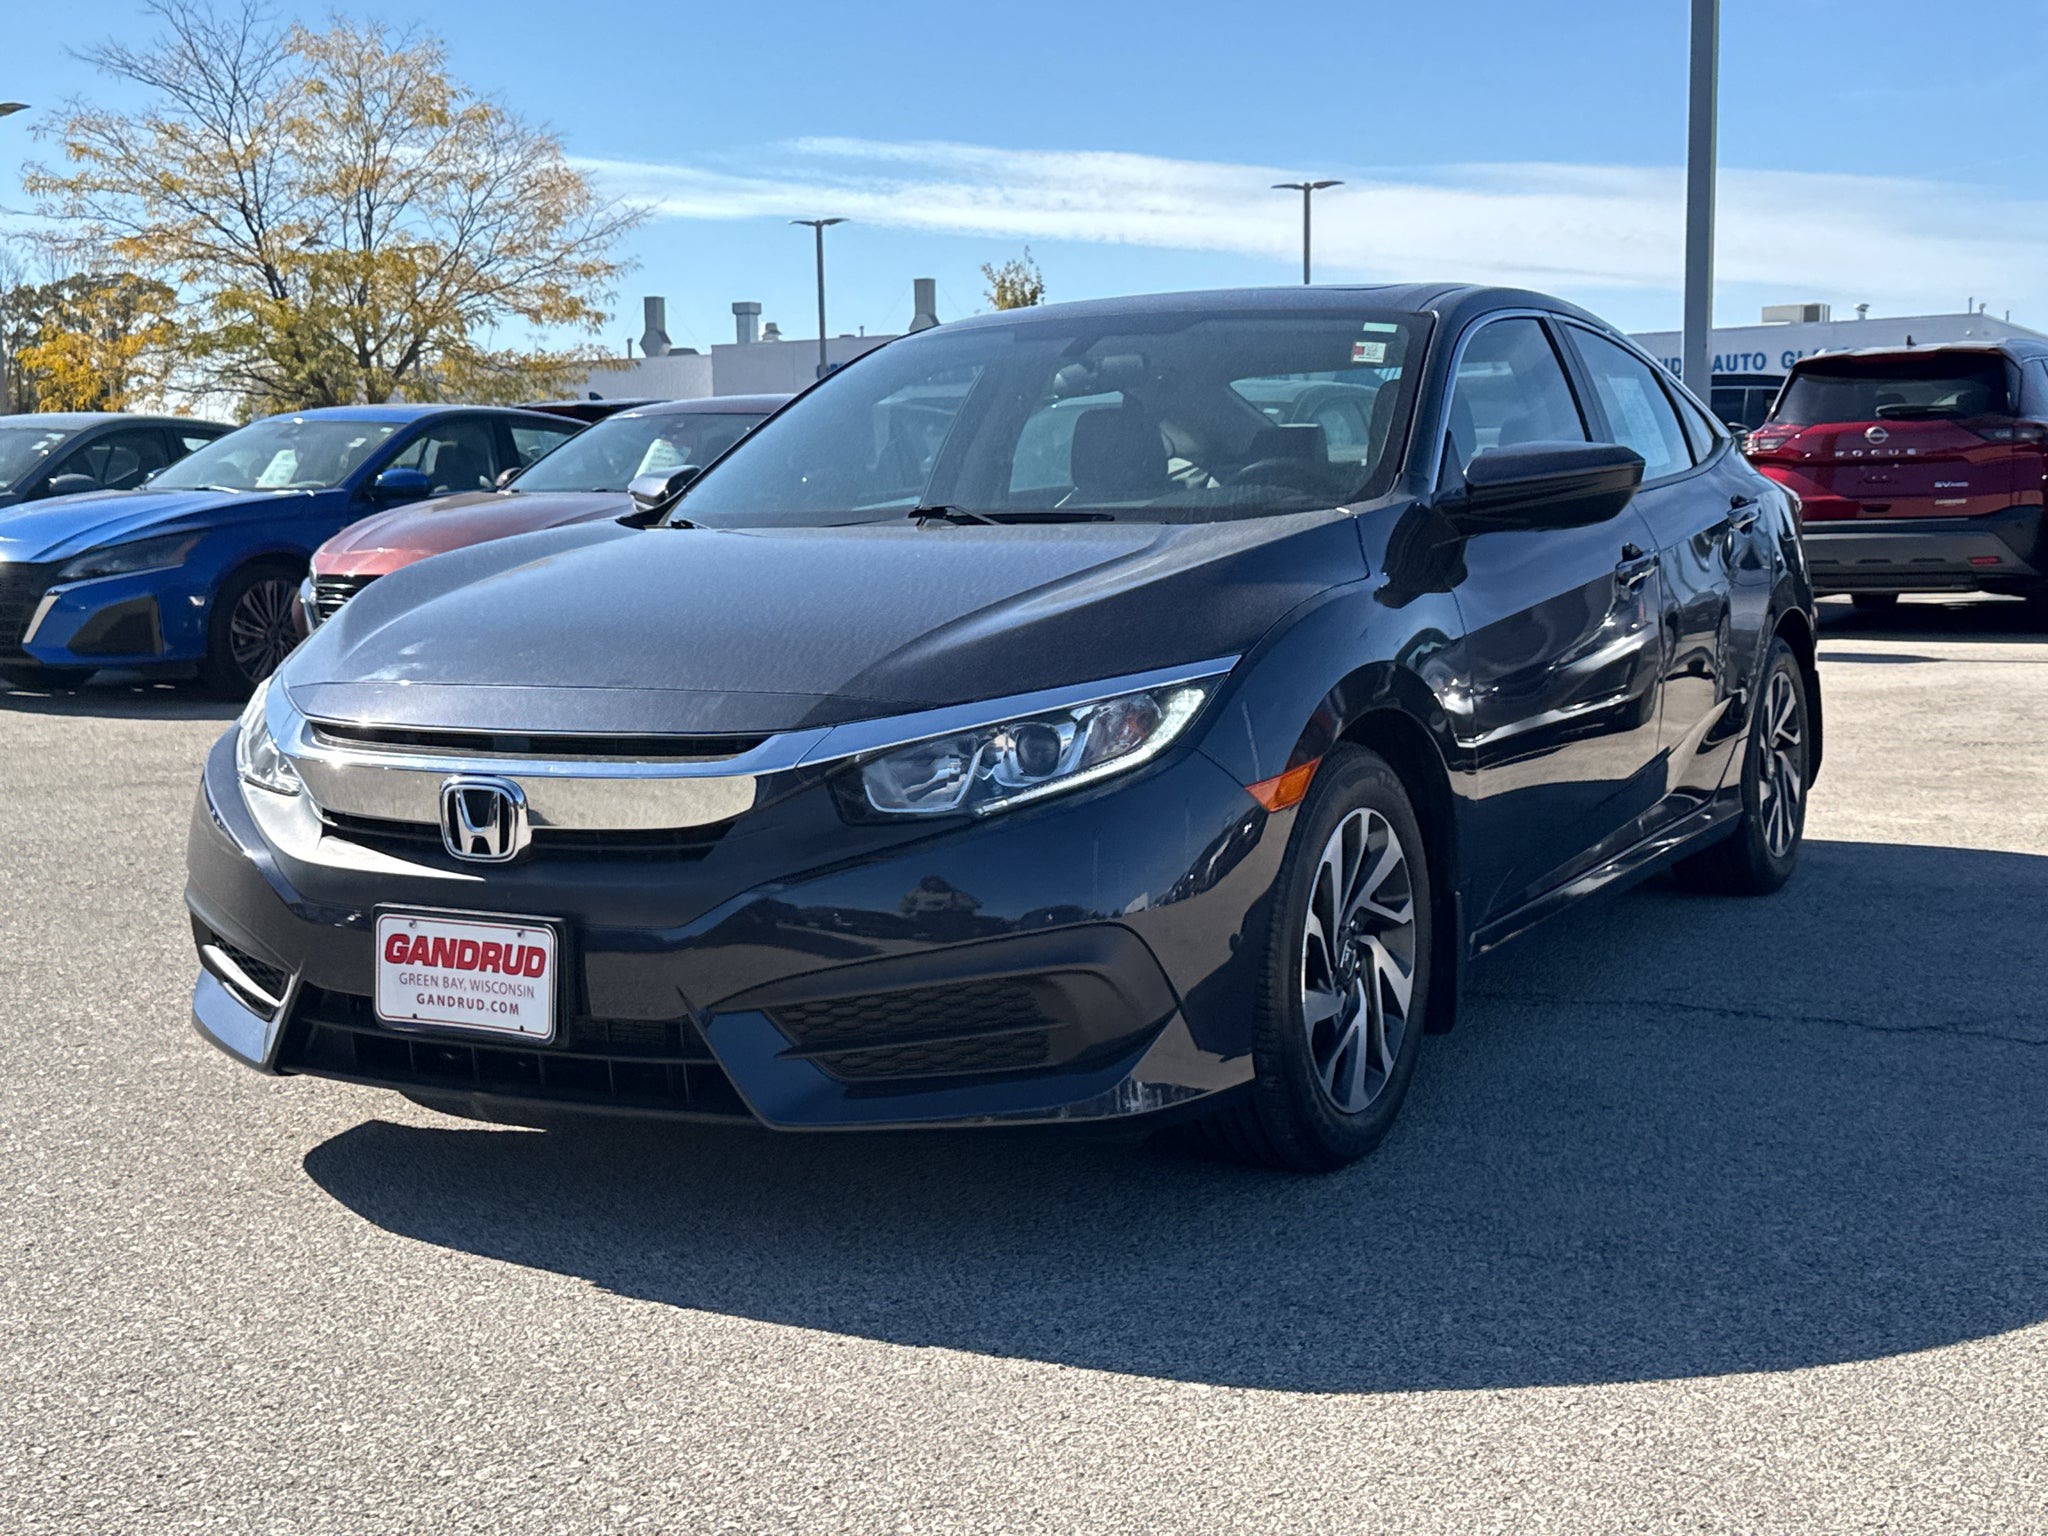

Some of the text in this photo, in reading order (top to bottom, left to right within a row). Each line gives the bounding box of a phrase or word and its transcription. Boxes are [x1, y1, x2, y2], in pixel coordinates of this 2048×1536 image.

[1711, 352, 1767, 372] AUTO
[384, 933, 547, 979] GANDRUD
[399, 972, 535, 999] GREEN BAY, WISCONSIN
[416, 993, 520, 1015] GANDRUD.COM
